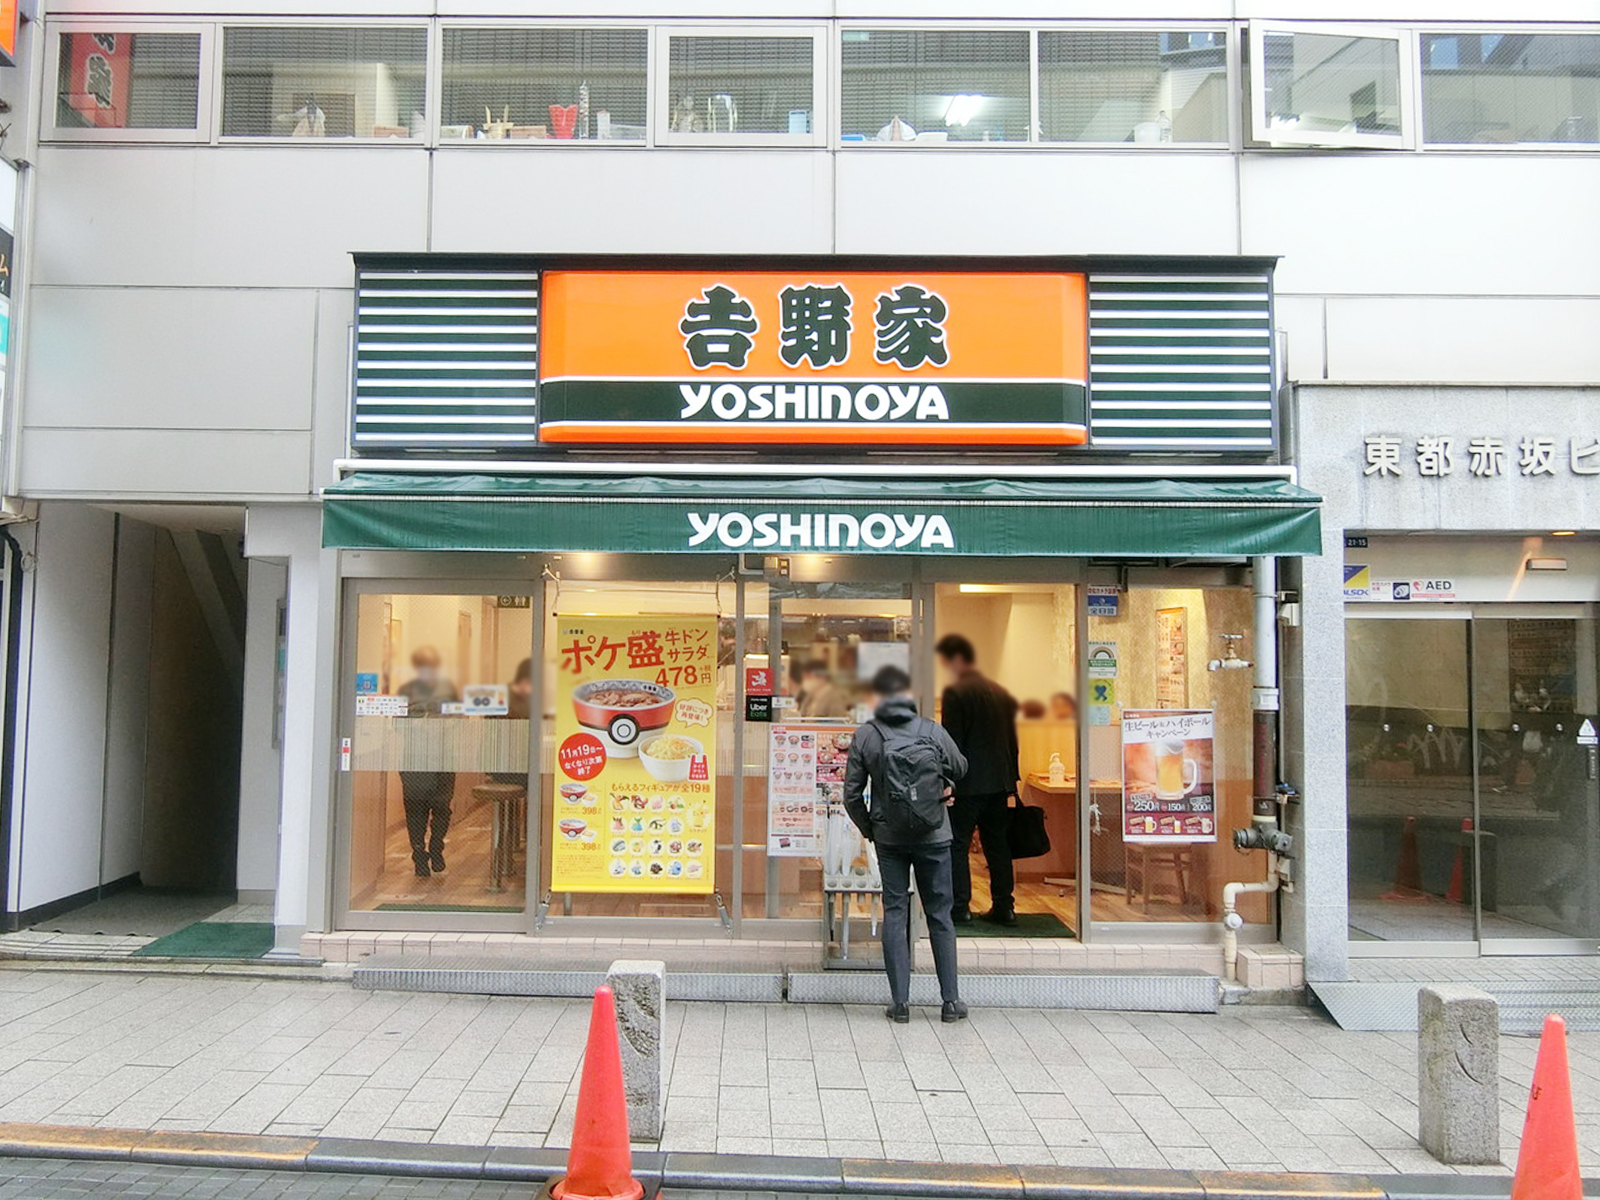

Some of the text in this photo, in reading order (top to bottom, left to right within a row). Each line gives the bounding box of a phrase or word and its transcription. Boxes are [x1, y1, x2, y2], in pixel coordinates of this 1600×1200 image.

[678, 283, 950, 370] 吉野家
[679, 384, 949, 420] YOSHINOYA
[687, 512, 955, 549] YOSHINOYA
[1425, 581, 1452, 590] AED
[665, 629, 708, 646] 牛ドン
[561, 630, 665, 674] ポケ盛
[667, 643, 710, 663] サラダ
[749, 703, 768, 711] Uber
